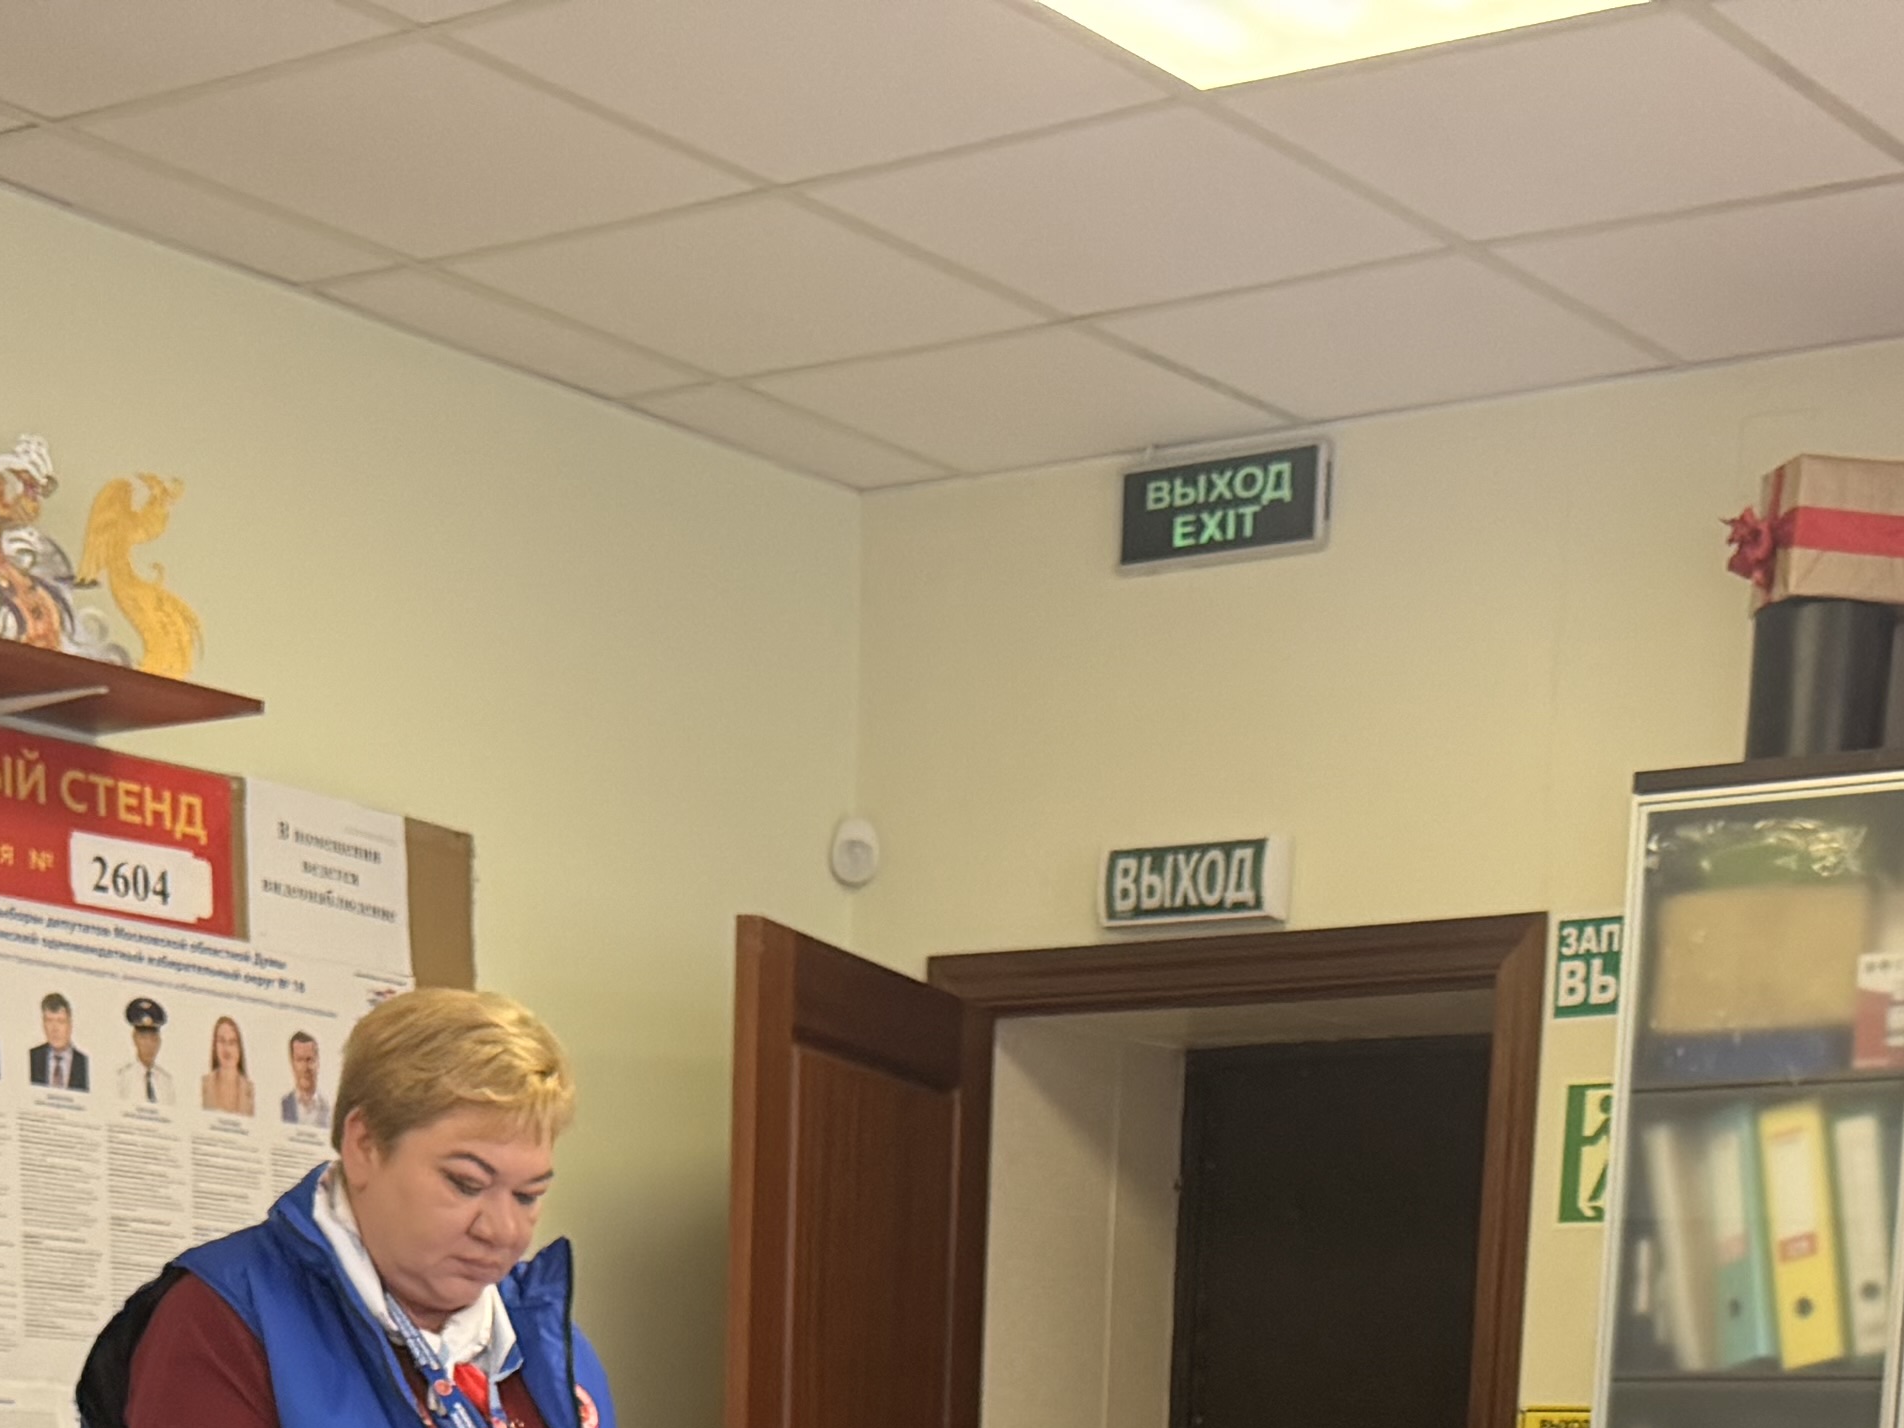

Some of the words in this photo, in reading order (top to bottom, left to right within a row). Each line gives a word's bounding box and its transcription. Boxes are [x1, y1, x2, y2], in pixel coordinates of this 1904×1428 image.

[1146, 461, 1292, 511] ВЫХОД
[1172, 504, 1262, 548] EXIT
[60, 770, 208, 845] СТЕНД
[29, 846, 53, 871] №
[92, 855, 170, 906] 2604
[1112, 847, 1258, 913] ВЫХОД
